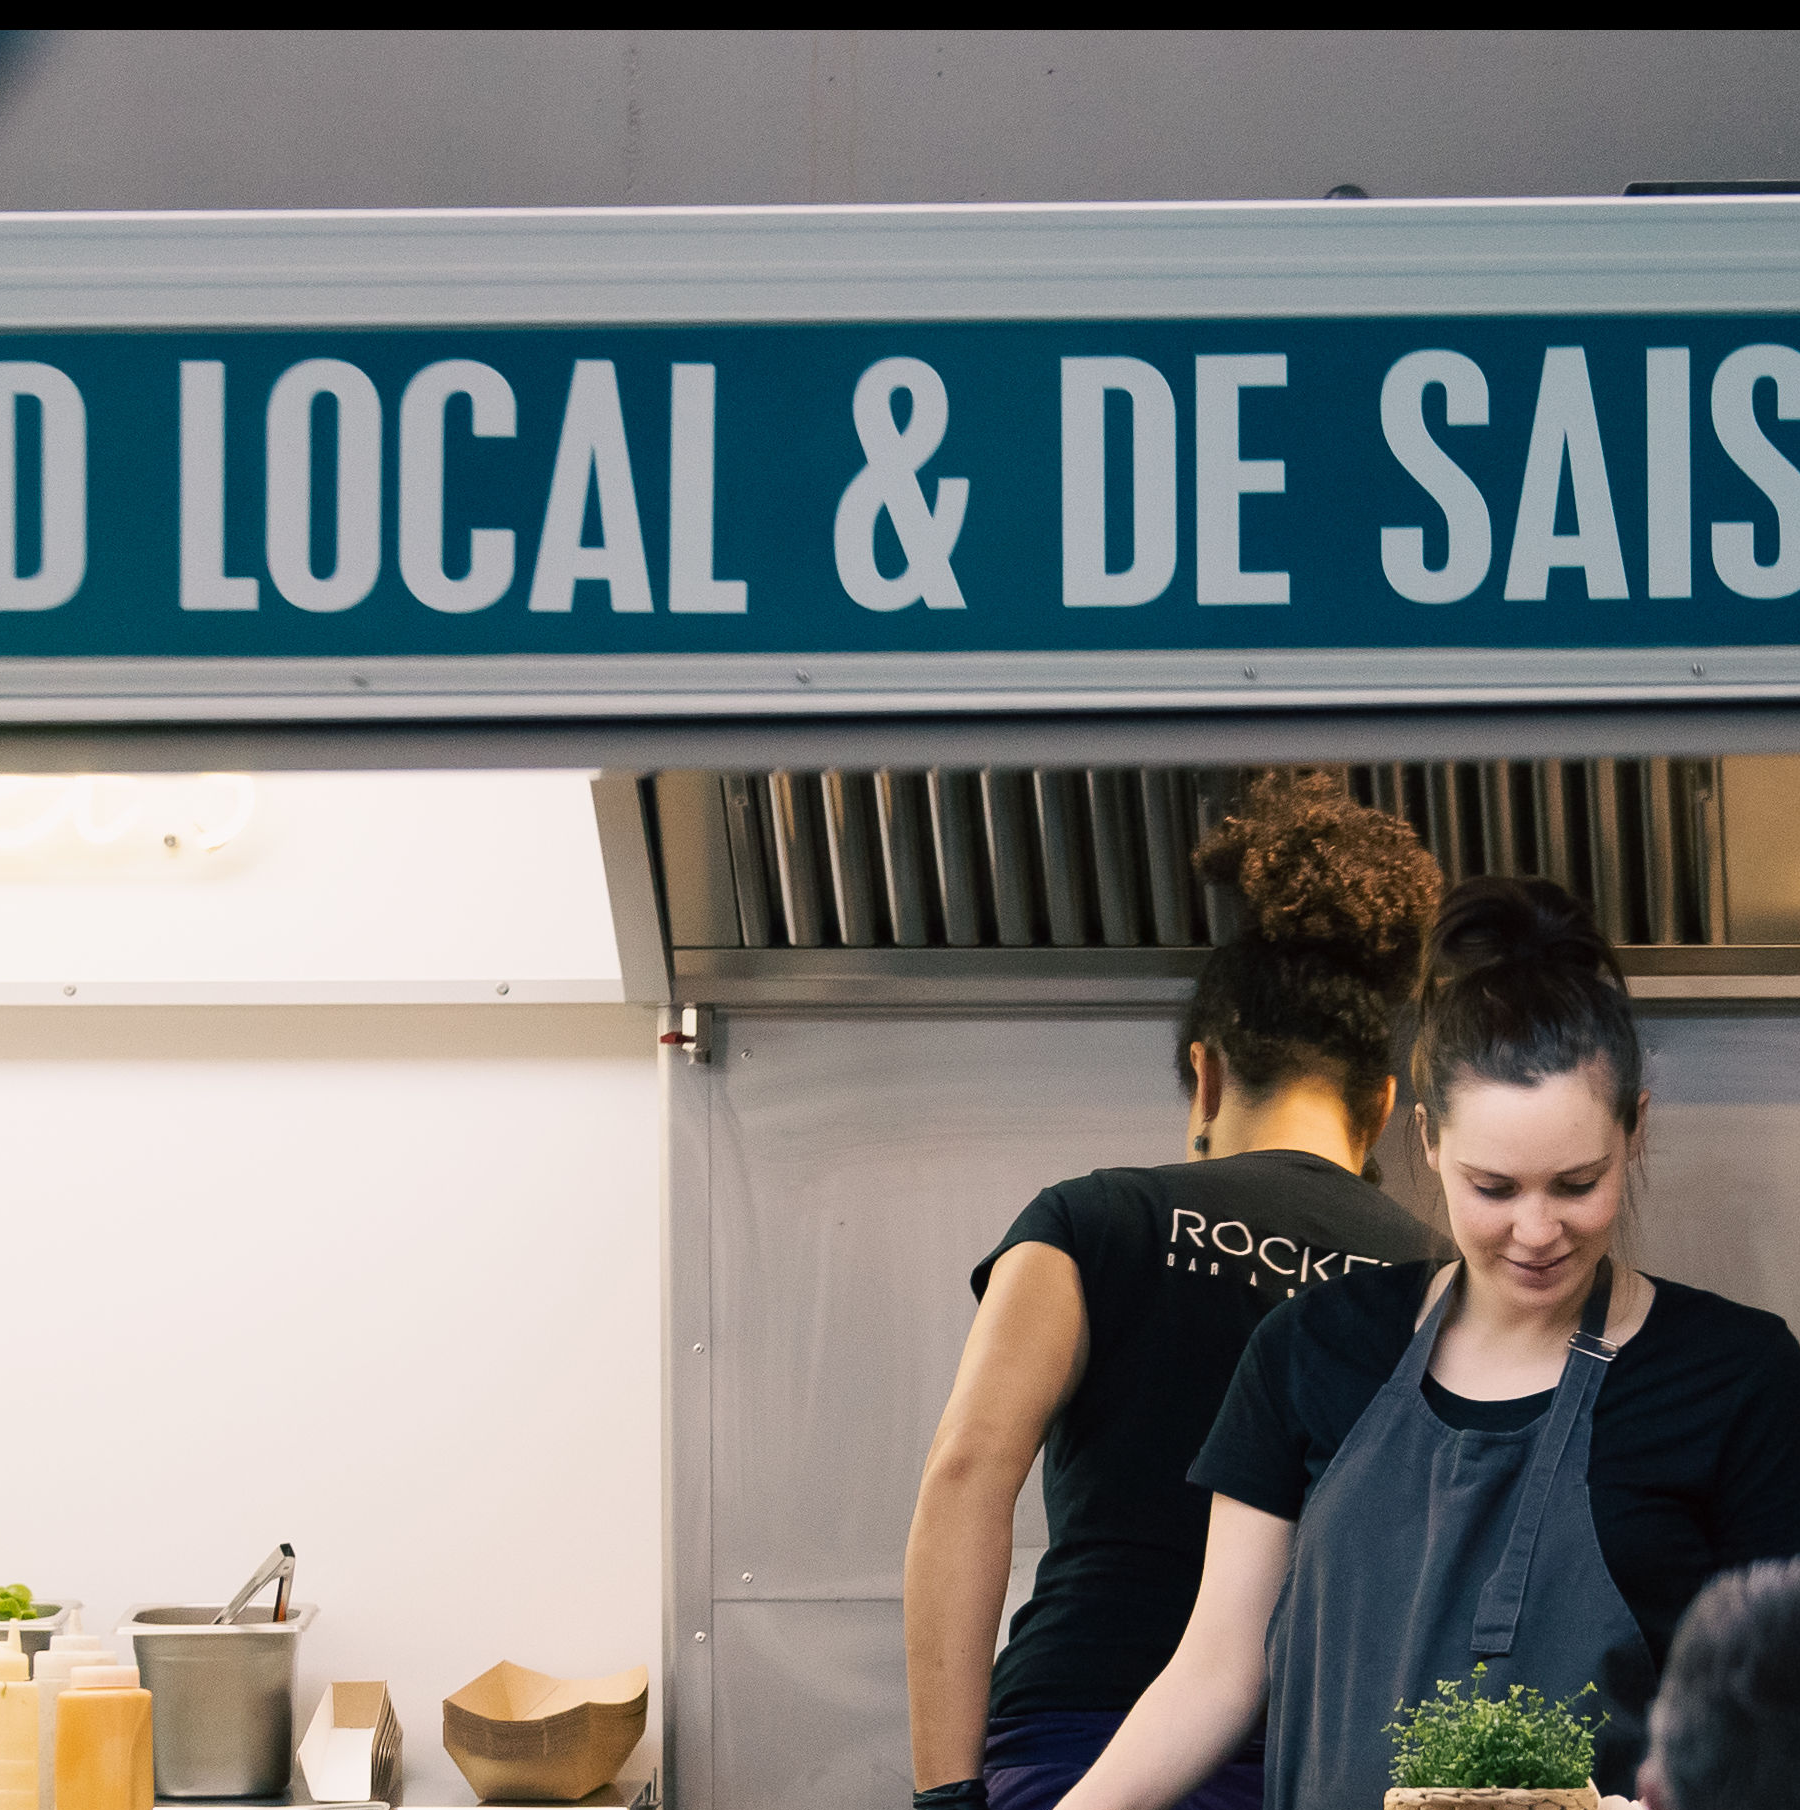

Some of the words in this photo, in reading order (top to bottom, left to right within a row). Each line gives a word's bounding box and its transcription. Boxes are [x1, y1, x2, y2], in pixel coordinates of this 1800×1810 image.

[177, 357, 749, 615] LOCAL
[832, 355, 971, 613] &
[1059, 353, 1292, 608] DE
[1166, 1252, 1220, 1276] BAR
[1170, 1207, 1393, 1284] ROCK
